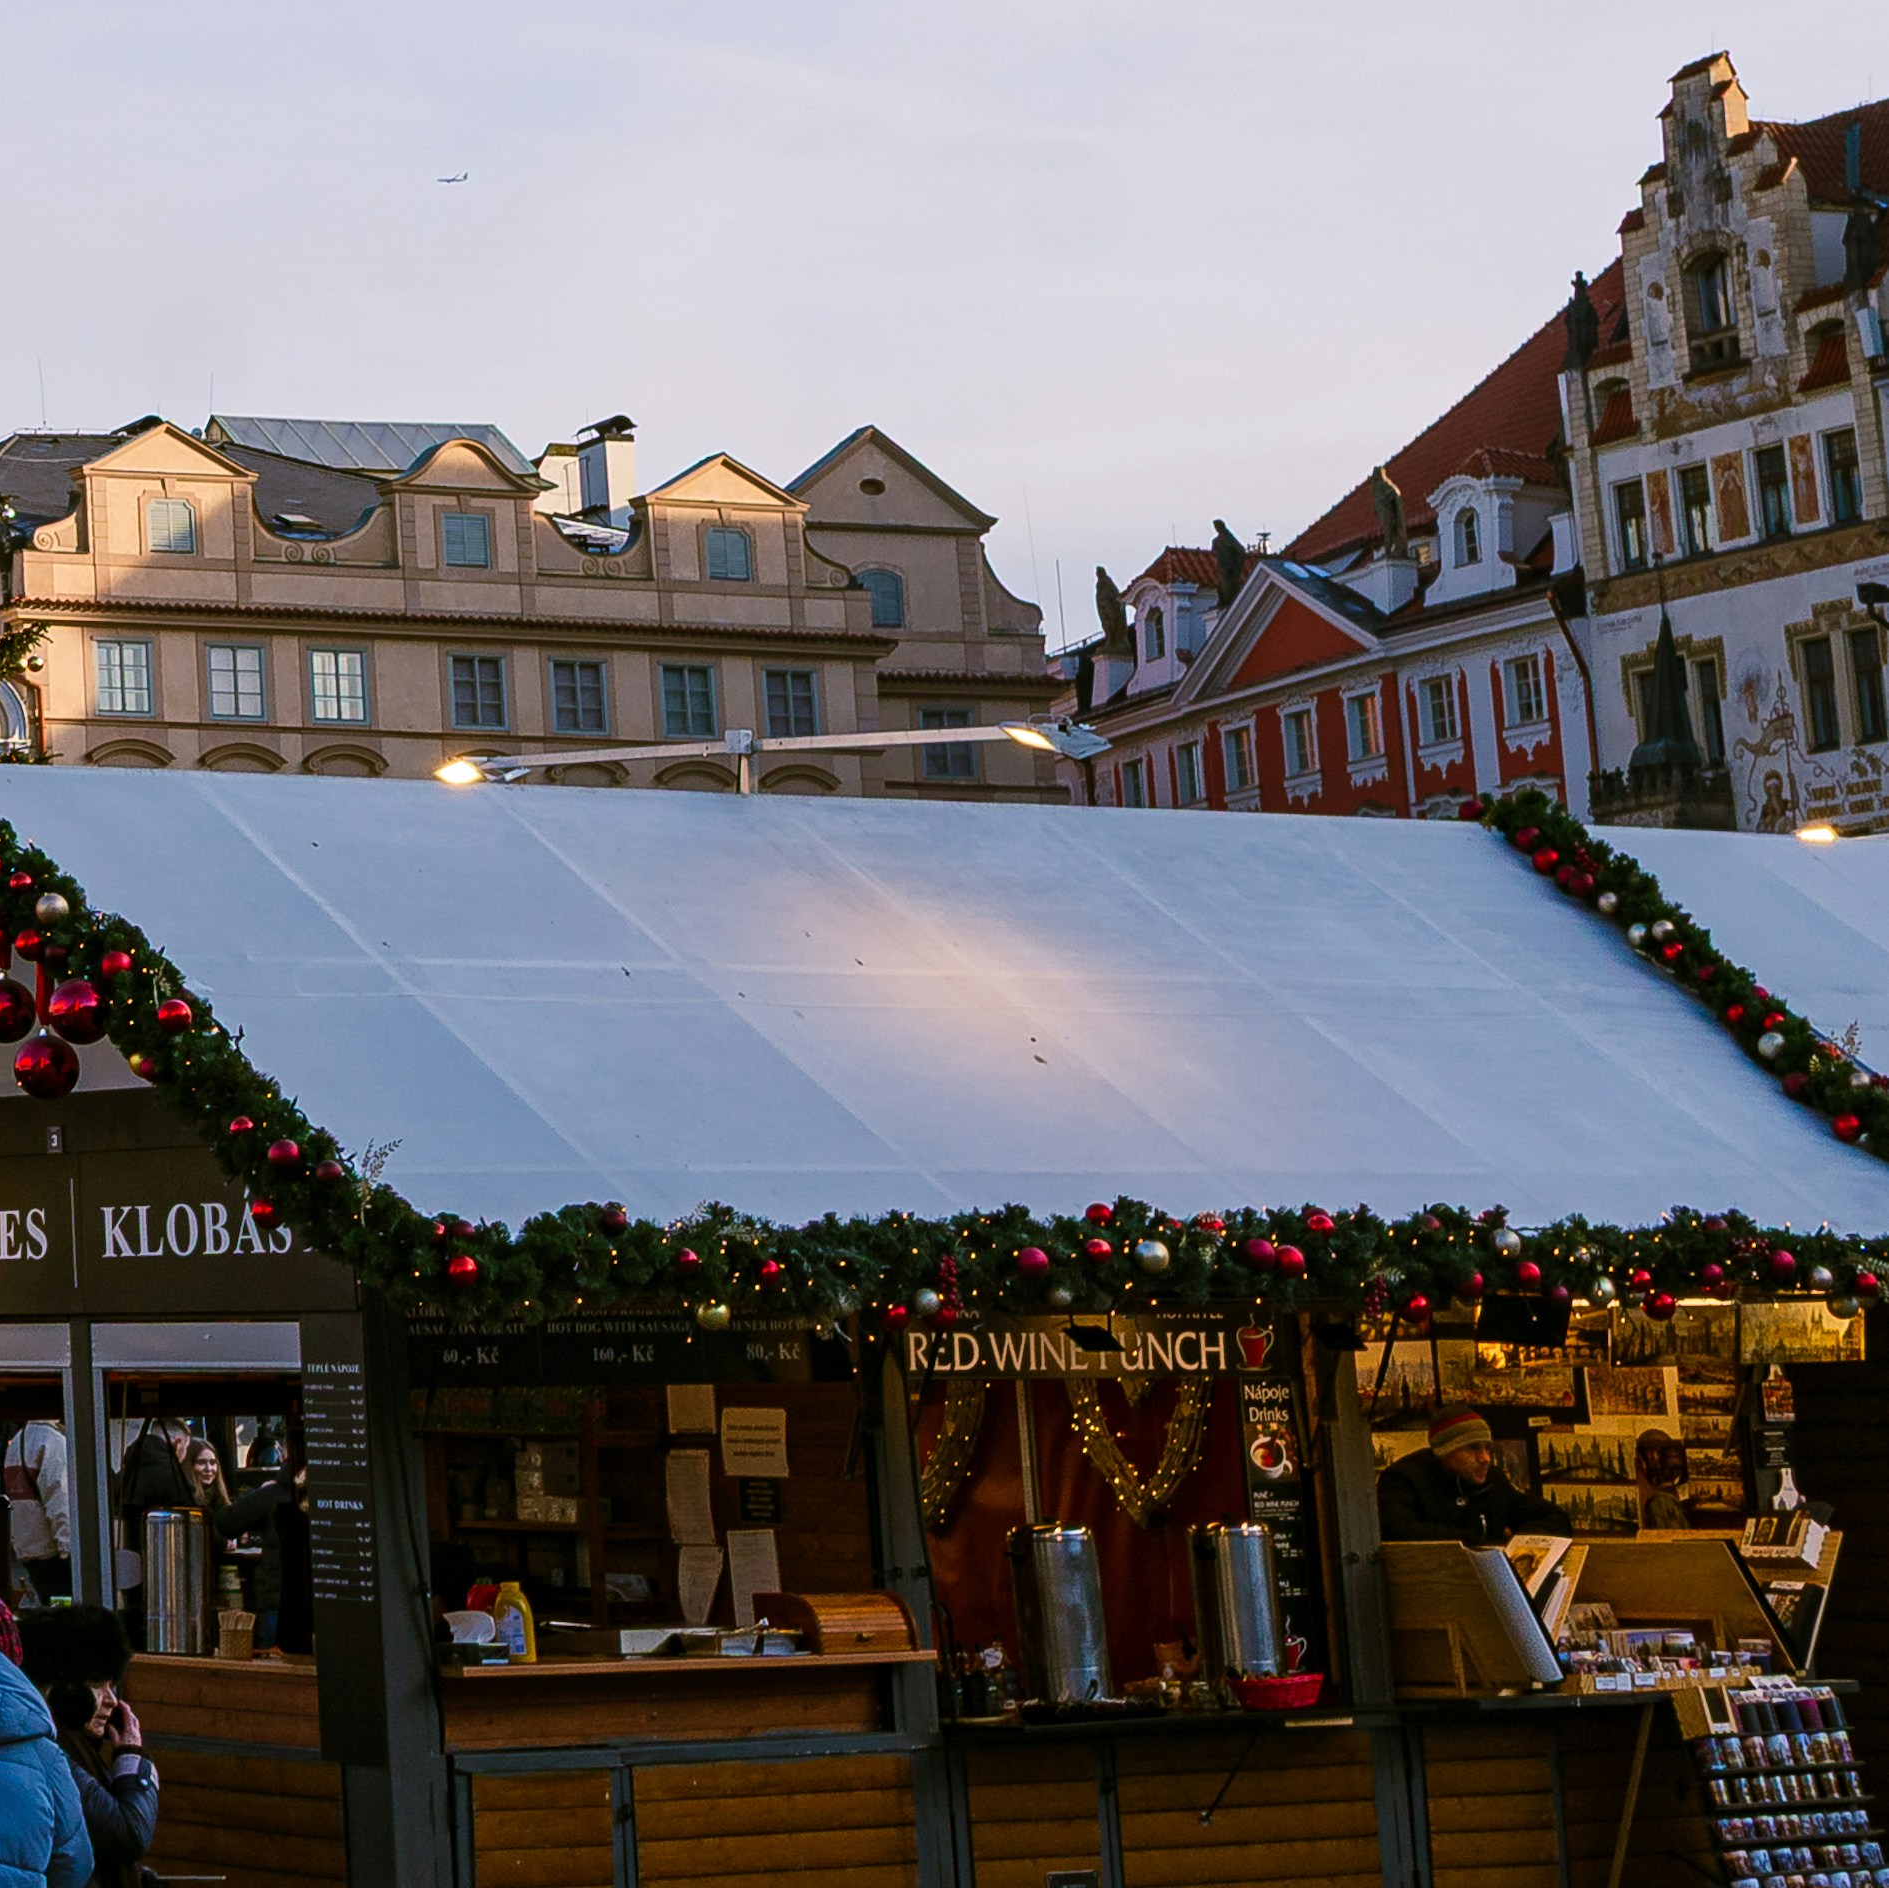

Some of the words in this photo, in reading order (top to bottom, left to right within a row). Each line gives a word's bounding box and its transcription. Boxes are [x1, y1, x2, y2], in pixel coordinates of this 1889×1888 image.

[51, 1134, 59, 1148] 3
[100, 1184, 315, 1259] KLOBÁS
[547, 1322, 571, 1334] HOT
[575, 1322, 601, 1334] DOG
[603, 1321, 636, 1334] WITH
[476, 1345, 501, 1365] Kč
[632, 1343, 655, 1363] Kč
[778, 1341, 801, 1361] Kč
[908, 1331, 979, 1371] RED
[1244, 1383, 1290, 1403] Nápoje
[1249, 1406, 1290, 1422] Drinks
